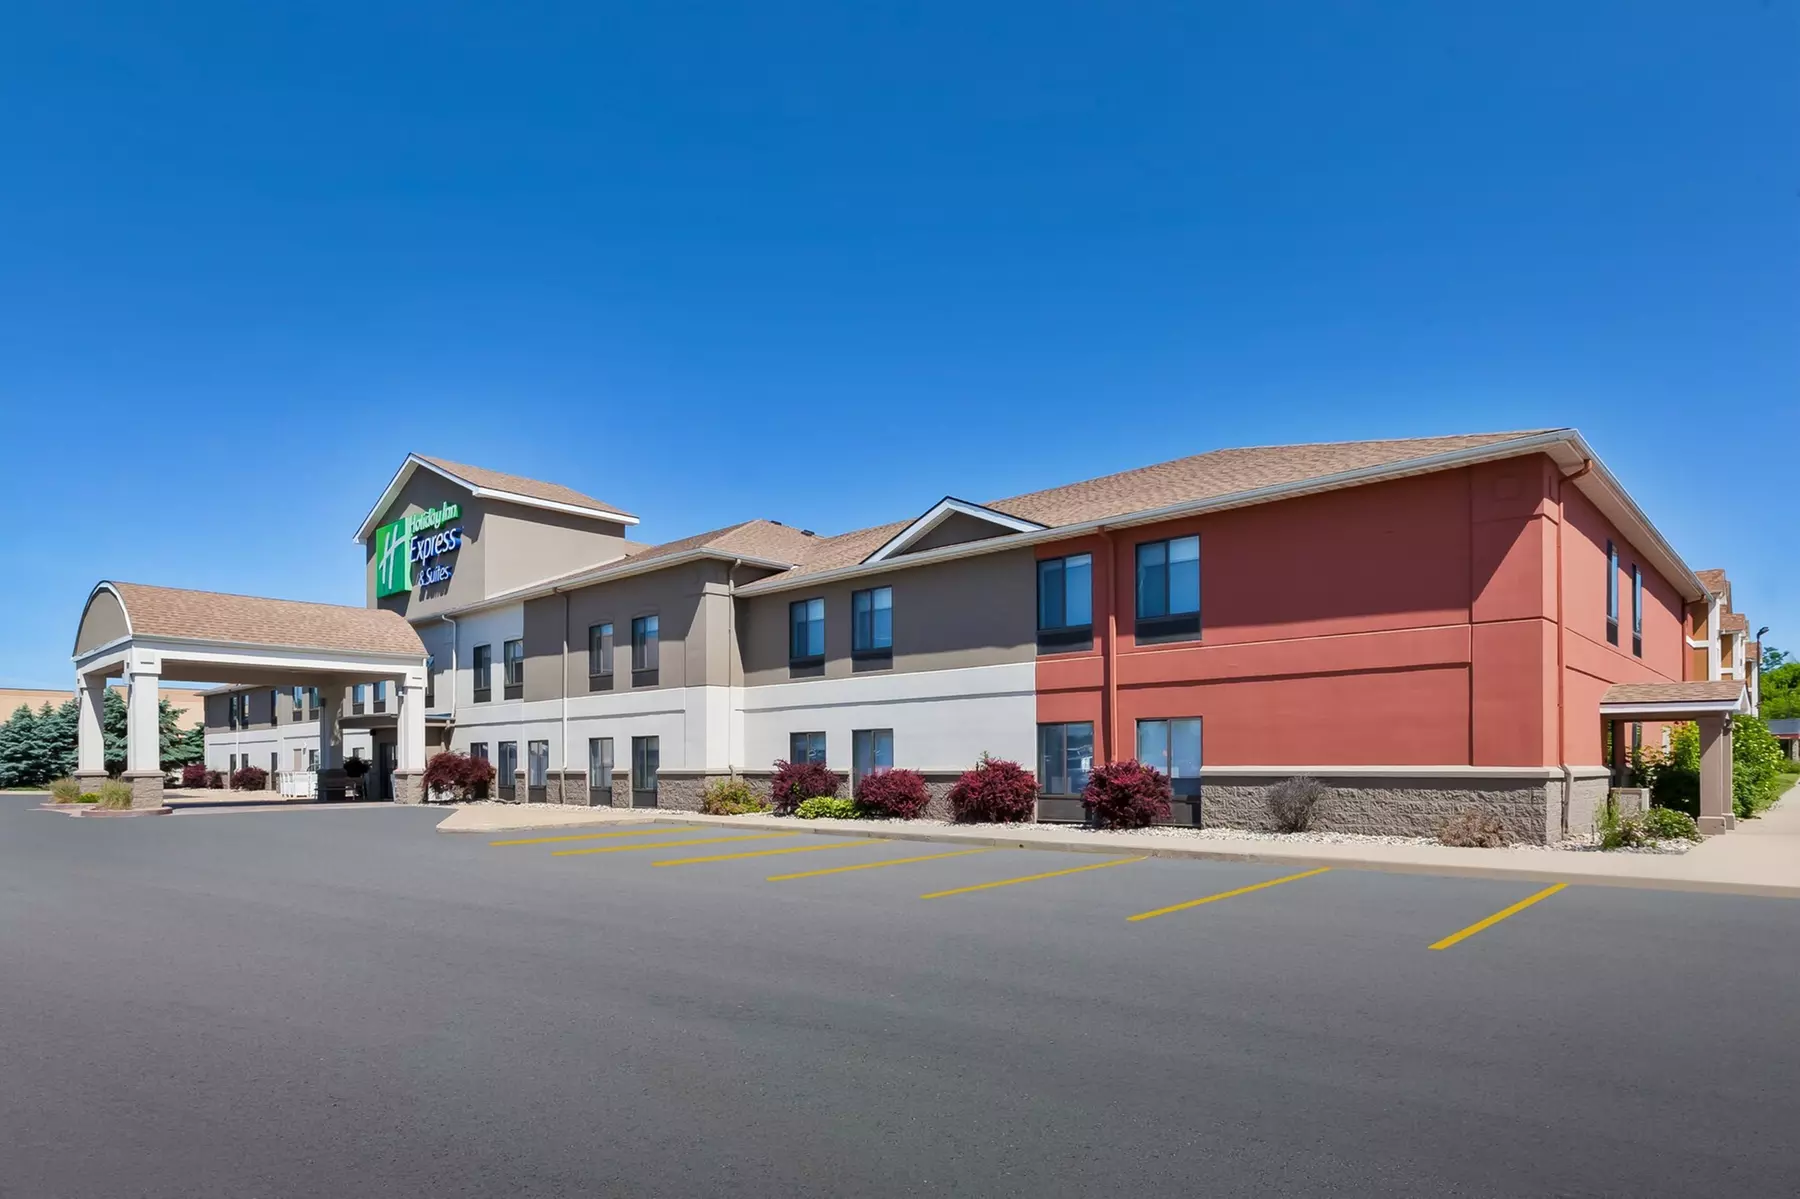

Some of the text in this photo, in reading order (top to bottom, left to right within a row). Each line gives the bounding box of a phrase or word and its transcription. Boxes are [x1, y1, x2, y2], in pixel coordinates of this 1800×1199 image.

[410, 501, 460, 533] Holiday Inn
[410, 528, 457, 566] Express
[418, 565, 450, 587] & Suites
